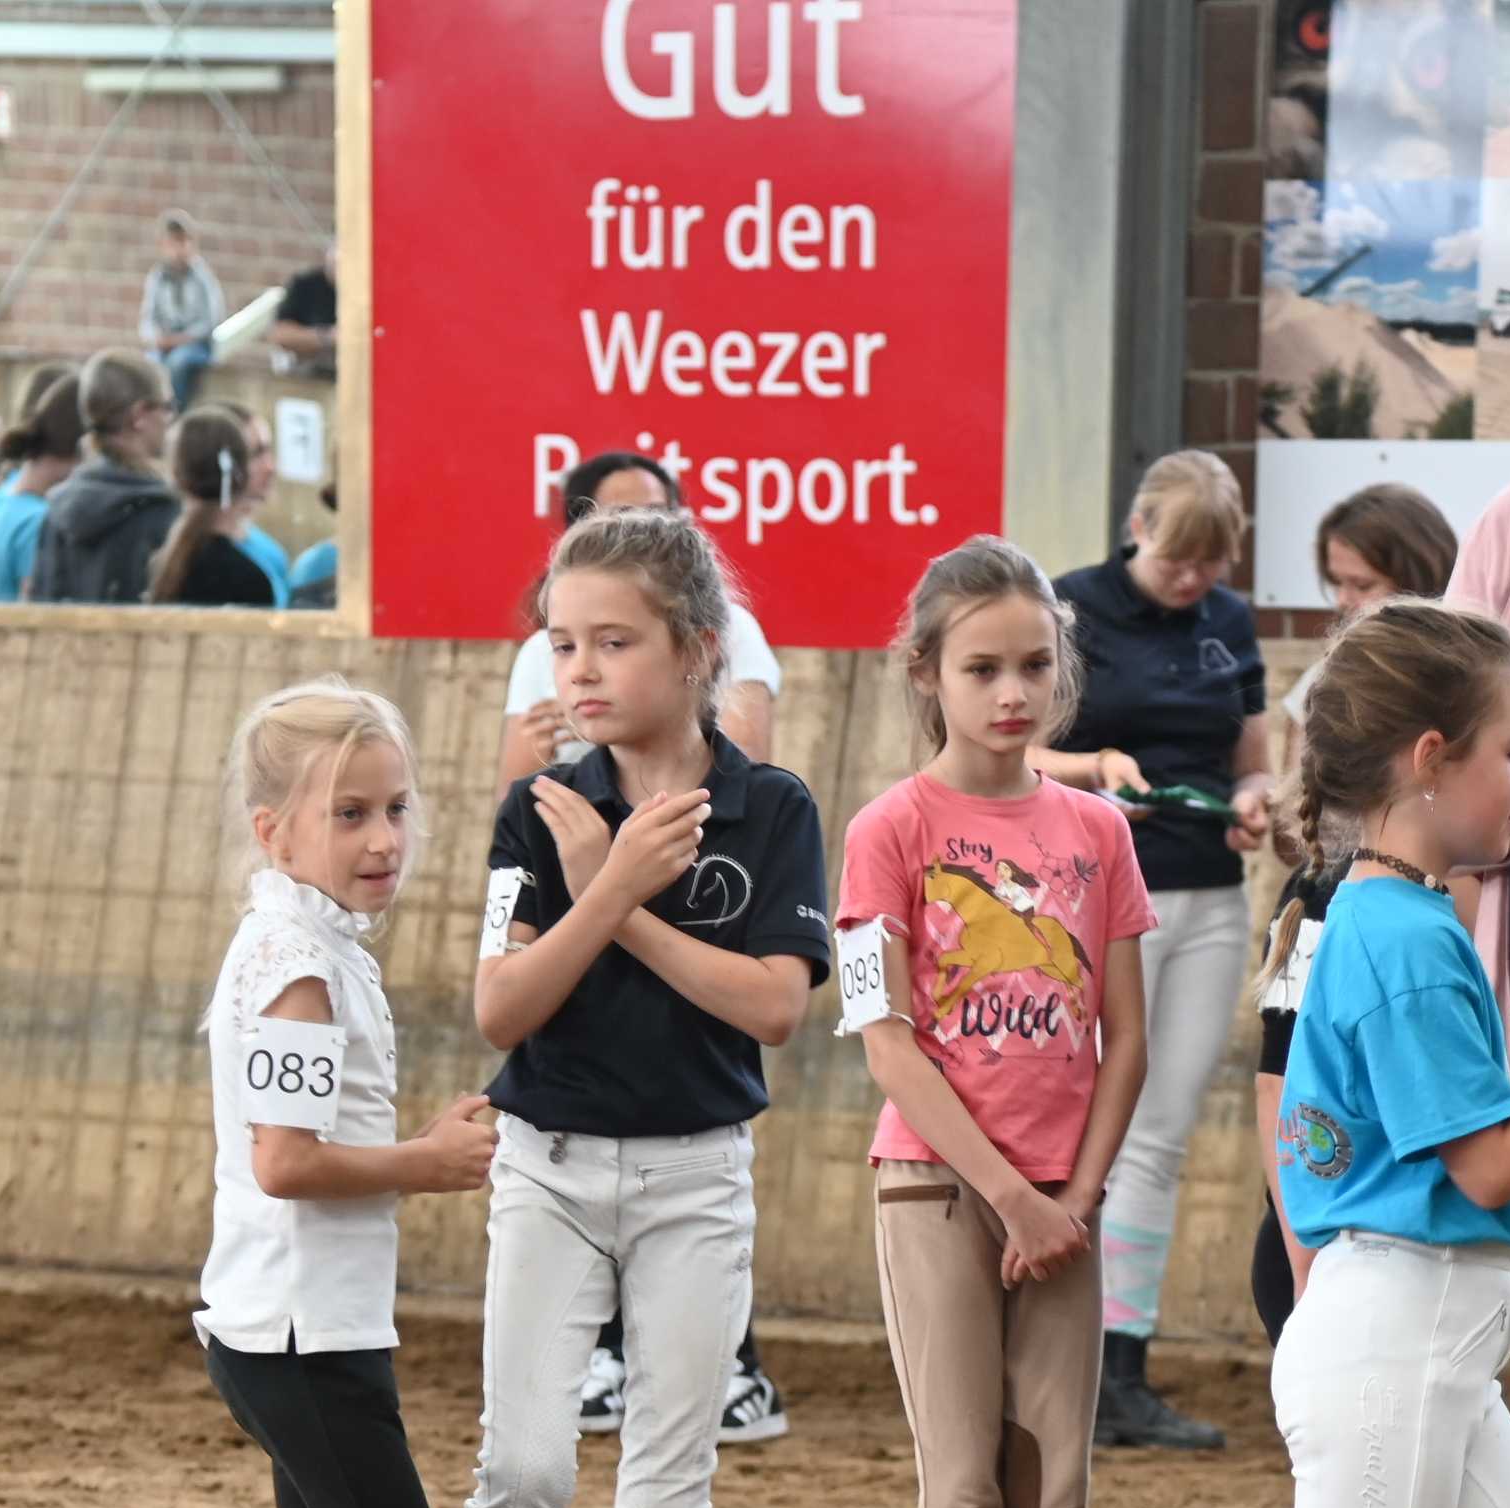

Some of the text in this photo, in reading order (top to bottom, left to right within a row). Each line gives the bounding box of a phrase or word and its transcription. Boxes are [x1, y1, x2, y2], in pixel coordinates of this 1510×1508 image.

[601, 0, 864, 118] Gut
[587, 178, 877, 270] für den
[581, 309, 887, 397] Weezer
[534, 433, 939, 544] Rtsport.
[842, 952, 880, 1000] 093
[961, 993, 1060, 1038] Wild
[247, 1049, 335, 1098] 083
